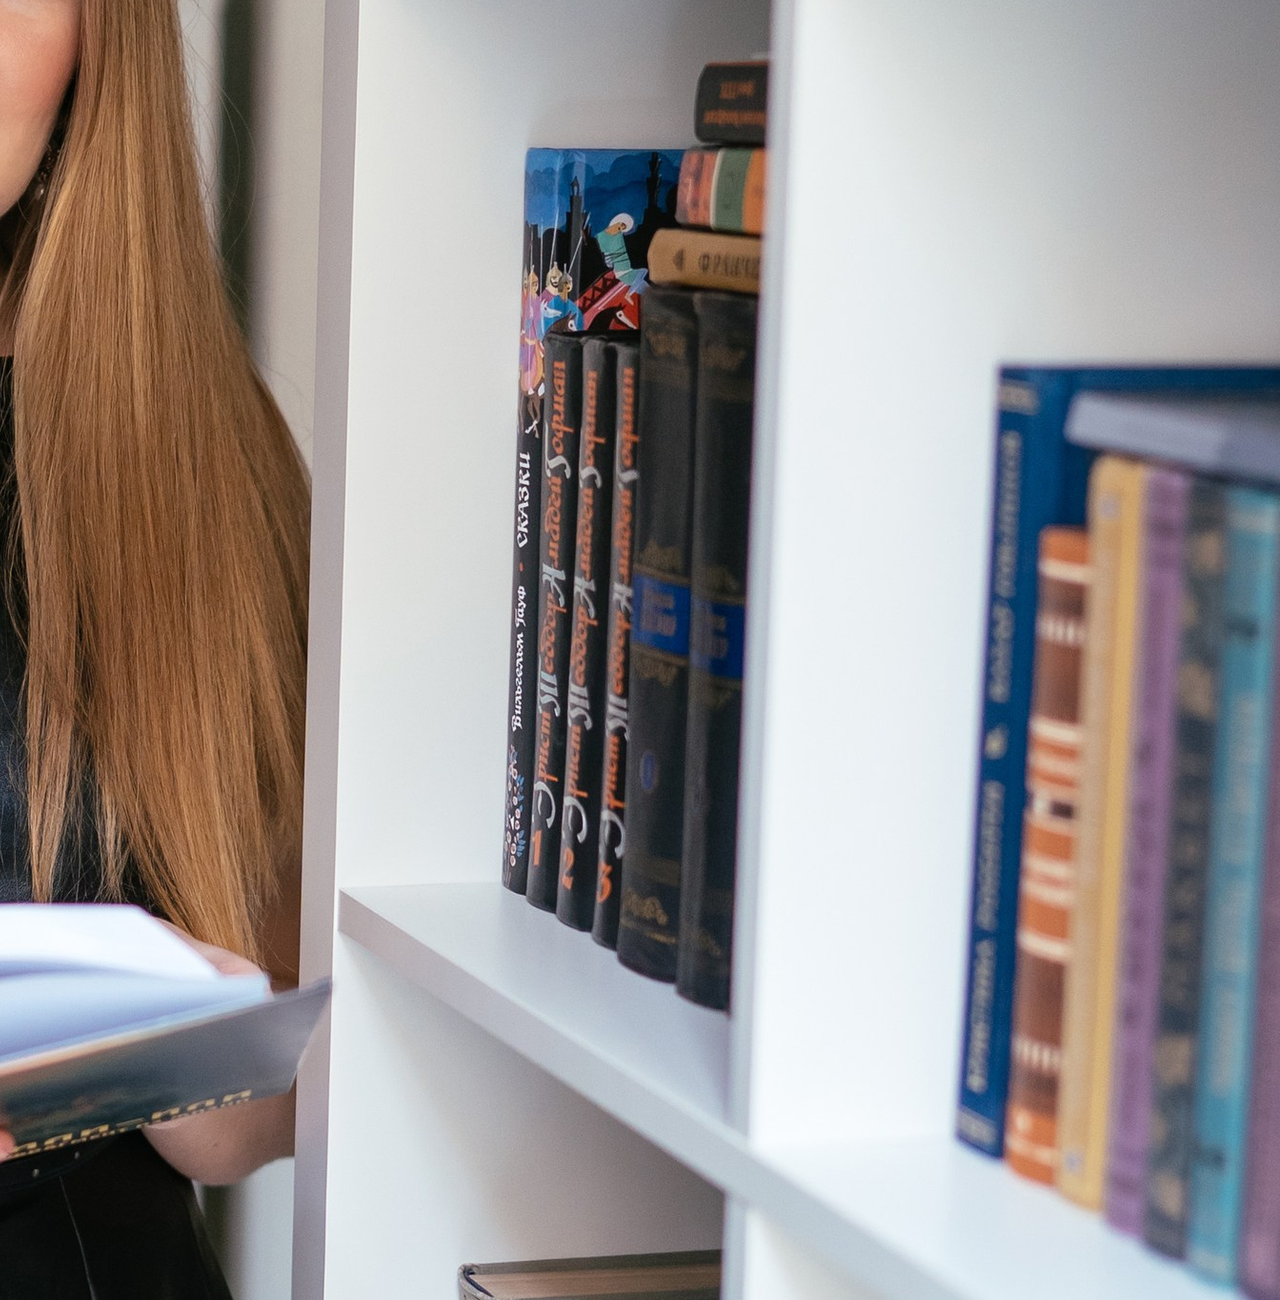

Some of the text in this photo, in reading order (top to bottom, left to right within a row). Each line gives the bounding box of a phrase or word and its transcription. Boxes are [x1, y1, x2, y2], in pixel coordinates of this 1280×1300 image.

[544, 360, 575, 480] Гофман
[578, 370, 606, 489] Гофман
[511, 451, 532, 732] Вильгельм Гауф СКАЗКИ
[538, 593, 568, 717] Теодор
[532, 829, 543, 867] 1
[560, 847, 576, 891] 2
[595, 860, 614, 903] 3
